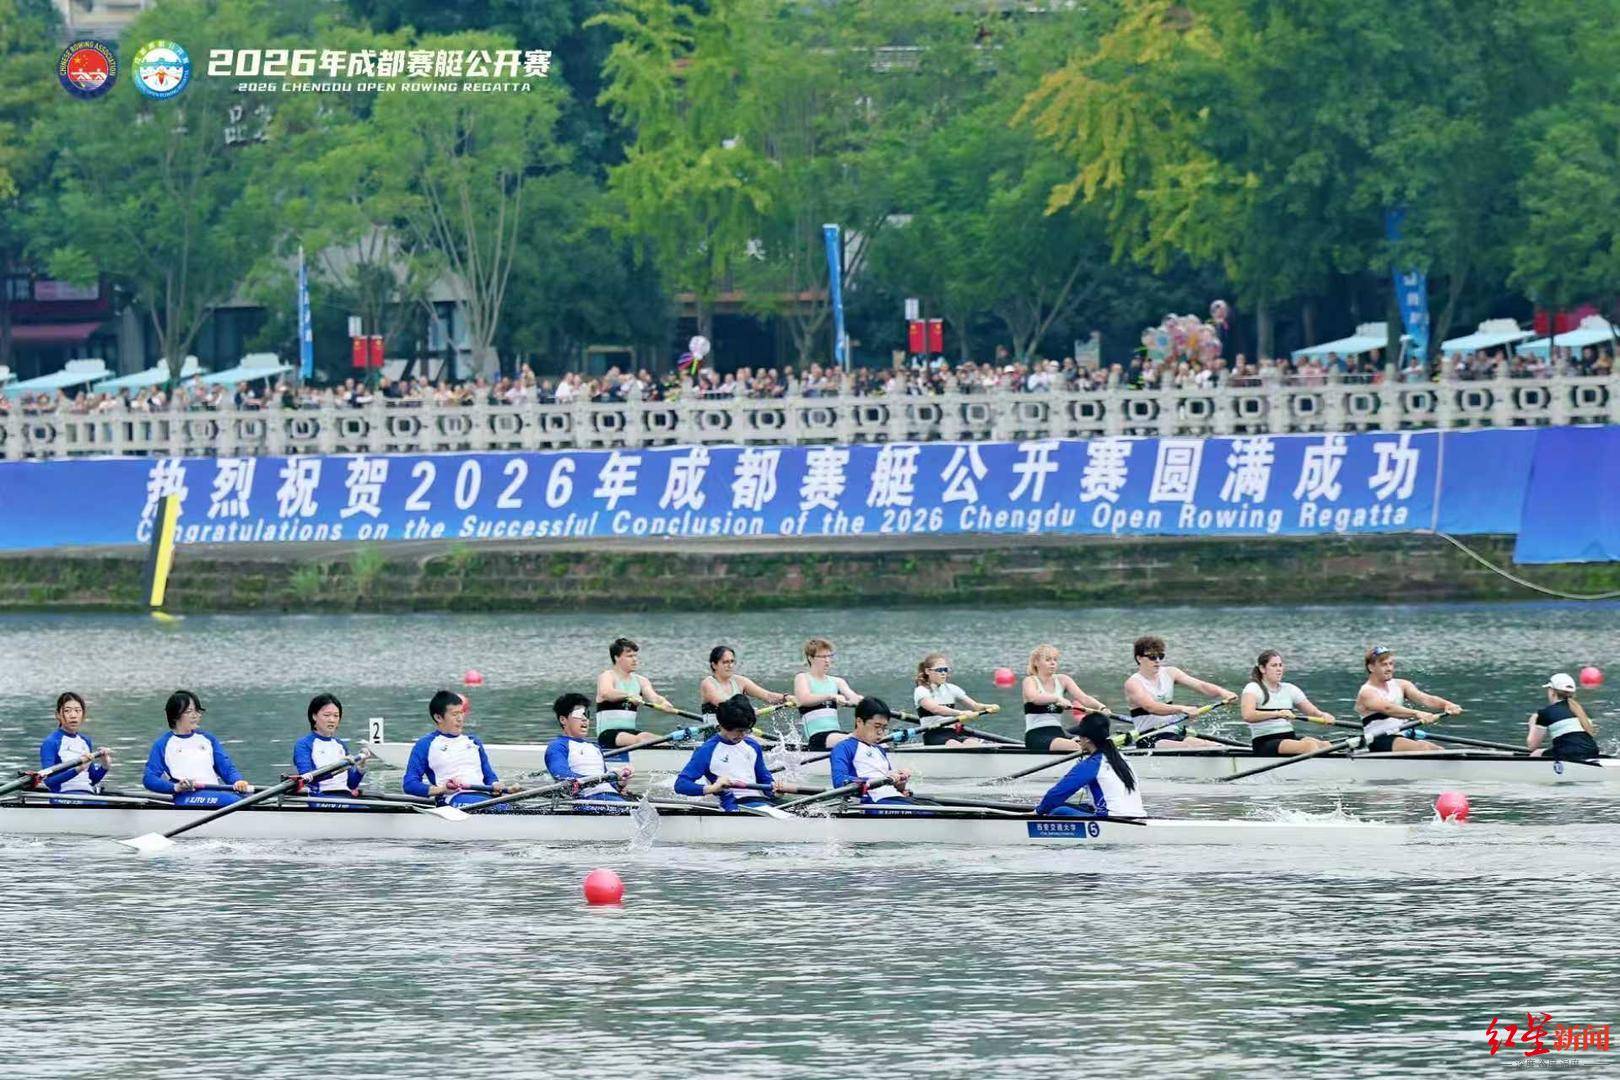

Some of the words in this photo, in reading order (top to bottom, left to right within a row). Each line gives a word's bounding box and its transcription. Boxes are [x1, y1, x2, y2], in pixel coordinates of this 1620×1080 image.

[358, 521, 389, 541] on
[405, 517, 445, 540] the
[458, 511, 598, 539] Successful
[612, 509, 764, 535] Conclusion
[780, 511, 808, 535] of
[822, 511, 865, 535] the
[880, 507, 943, 531] 2026
[960, 502, 1075, 532] Chengdu
[1092, 504, 1161, 533] Open
[1178, 502, 1283, 532] Rowing
[1299, 501, 1409, 531] Regatta
[373, 722, 380, 740] 2
